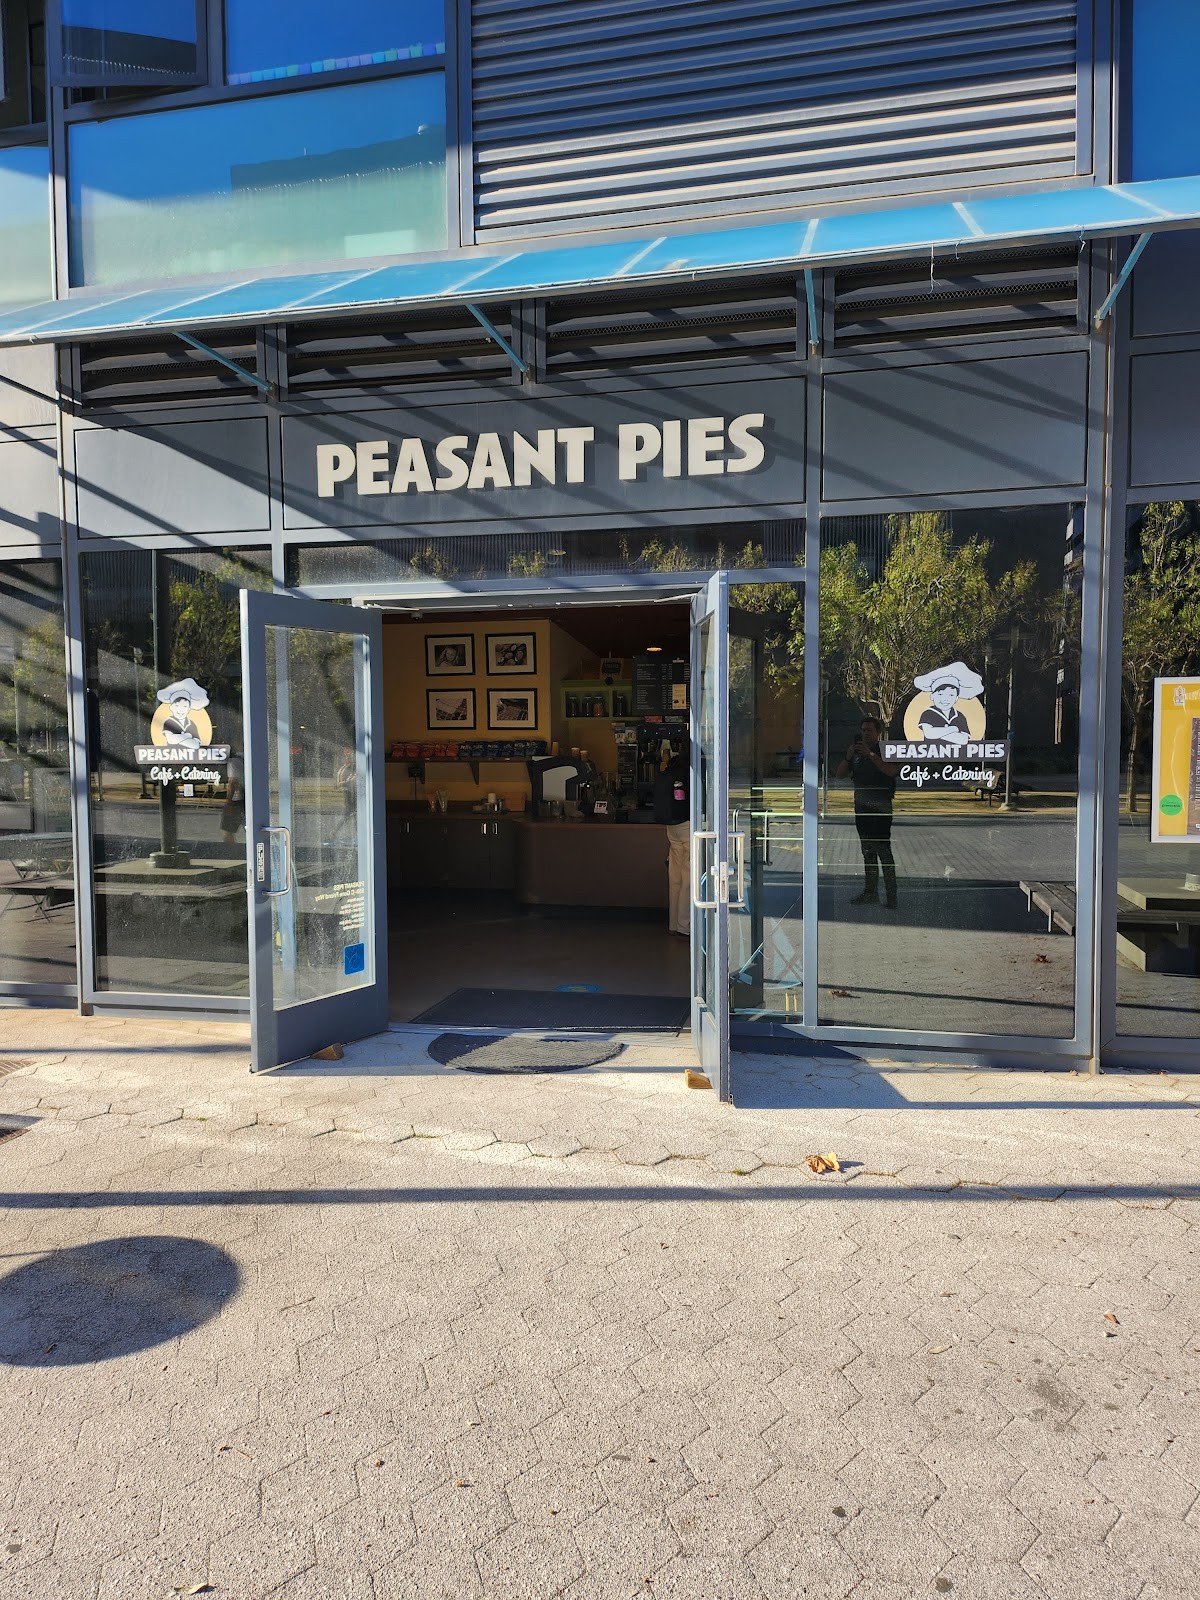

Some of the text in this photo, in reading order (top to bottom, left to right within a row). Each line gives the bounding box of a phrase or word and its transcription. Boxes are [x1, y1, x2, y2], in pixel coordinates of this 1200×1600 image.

[316, 413, 766, 498] PEASANT PIES
[138, 748, 227, 761] PEASANT PIES
[885, 743, 1005, 759] PEASANT PIES
[150, 766, 174, 786] Café
[181, 766, 221, 786] Catering
[900, 764, 996, 788] Café + Catering
